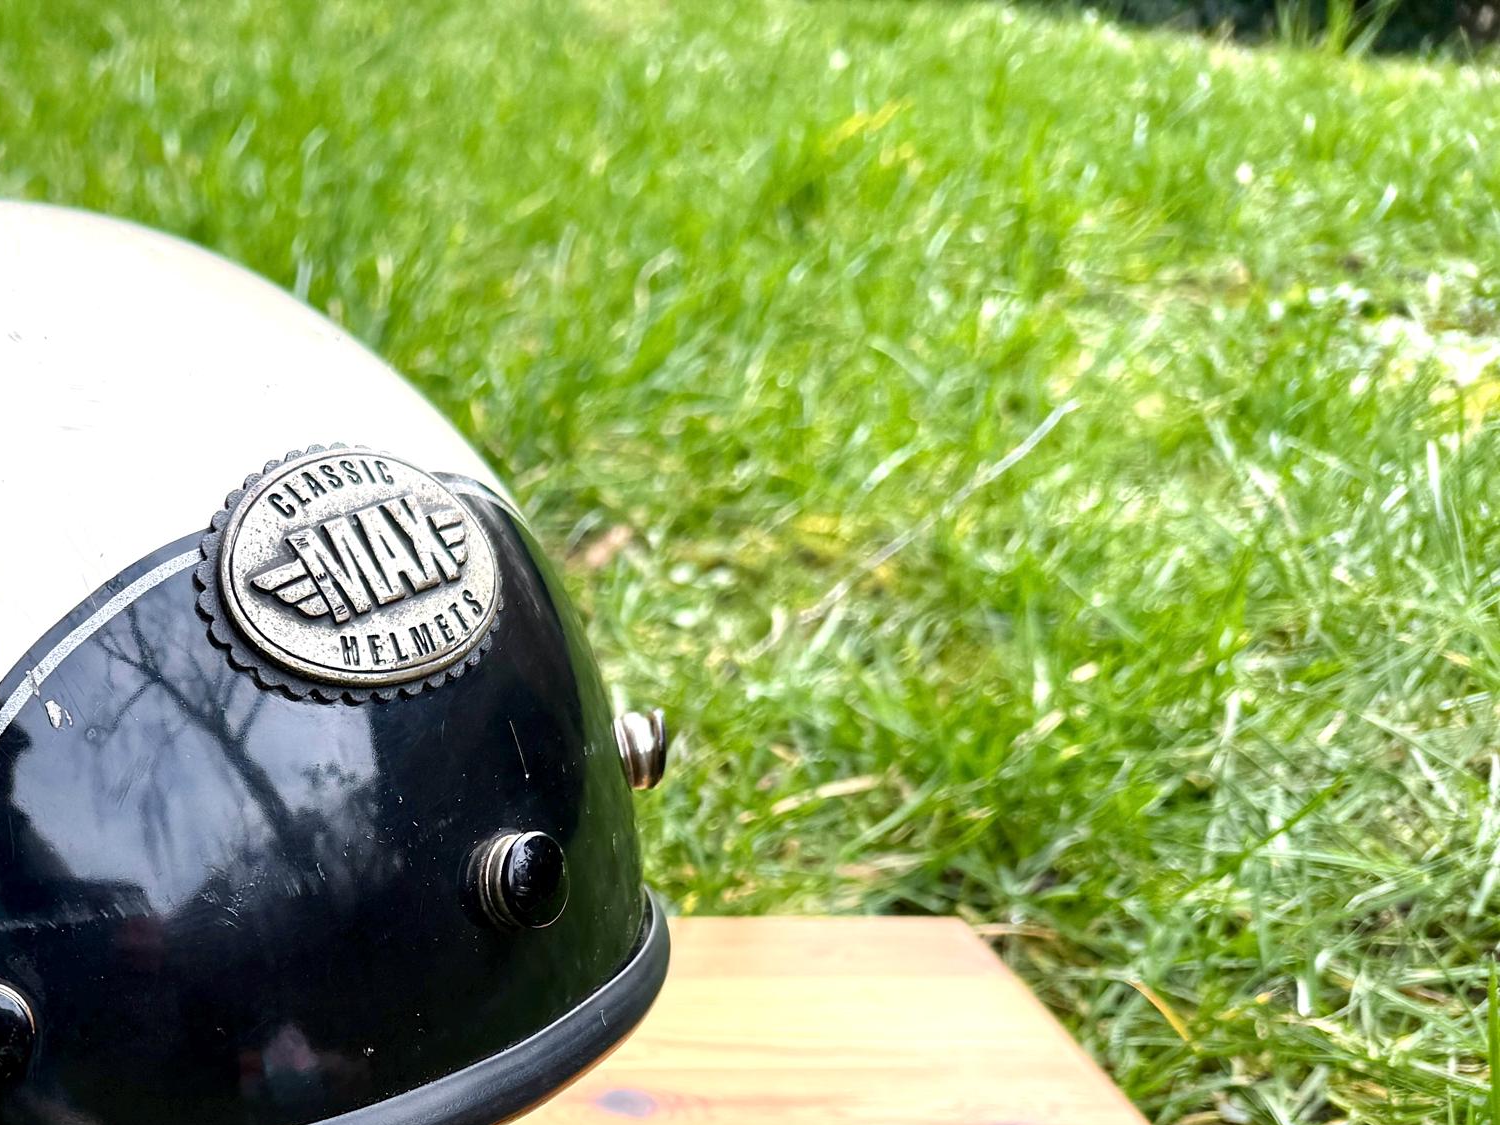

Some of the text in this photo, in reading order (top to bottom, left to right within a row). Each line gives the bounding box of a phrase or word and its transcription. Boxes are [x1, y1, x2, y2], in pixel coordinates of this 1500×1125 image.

[267, 459, 394, 519] CLASSIC
[285, 494, 461, 625] MAX
[339, 588, 484, 667] HELMETS
